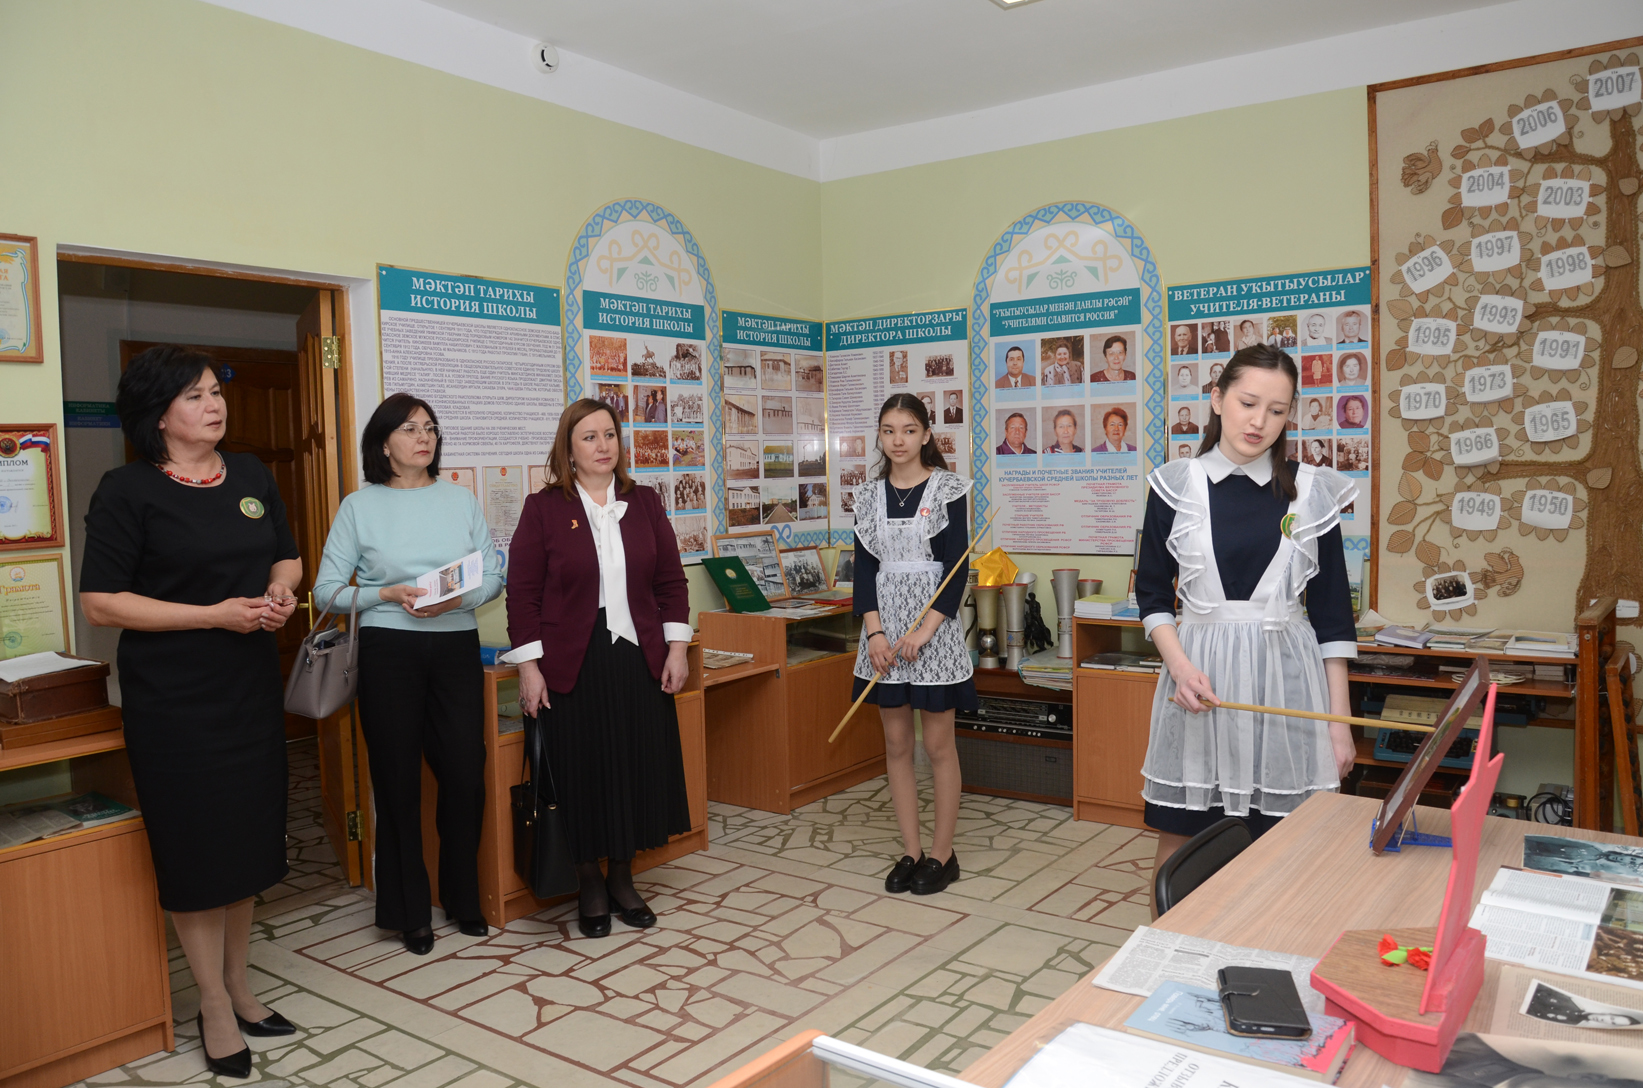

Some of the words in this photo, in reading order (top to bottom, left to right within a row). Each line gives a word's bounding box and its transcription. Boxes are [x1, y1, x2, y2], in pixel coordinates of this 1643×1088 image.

[1594, 72, 1636, 98] 2007
[1517, 106, 1558, 136] 2006
[1466, 171, 1505, 194] 2004
[1542, 186, 1584, 206] 2003
[1476, 235, 1514, 259] 1997
[1406, 250, 1443, 282] 1996
[1545, 252, 1587, 279] 1998
[478, 285, 534, 303] ТАРИХЫ
[1173, 285, 1238, 301] ВЕТЕРАН
[1190, 290, 1346, 315] УЧИТЕЛЯ-ВЕТЕРАНЫ
[410, 294, 480, 314] ИСТОРИЯ
[483, 302, 537, 319] ШКОЛЫ
[650, 303, 692, 319] ТАРИХЫ
[1076, 299, 1103, 310] ДАНЛЫ
[1480, 302, 1518, 326] 1993
[598, 312, 650, 328] ИСТОРИЯ
[652, 318, 694, 333] ШКОЛЫ
[776, 320, 810, 334] ТАРИХЫ
[1048, 313, 1085, 324] СЛАВИТСЯ
[737, 329, 776, 343] ИСТОРИЯ
[779, 335, 811, 347] ШКОЛЫ
[840, 330, 903, 346] ДИРЕКТОРА
[906, 326, 951, 339] ШКОЛЫ
[1414, 325, 1451, 346] 1995
[1539, 338, 1581, 360] 1991
[1468, 371, 1507, 394] 1973
[1405, 391, 1441, 411] 1970
[1529, 411, 1570, 434] 1965
[1455, 433, 1493, 455] 1966
[1458, 496, 1495, 517] 1949
[1528, 493, 1568, 516] 1950
